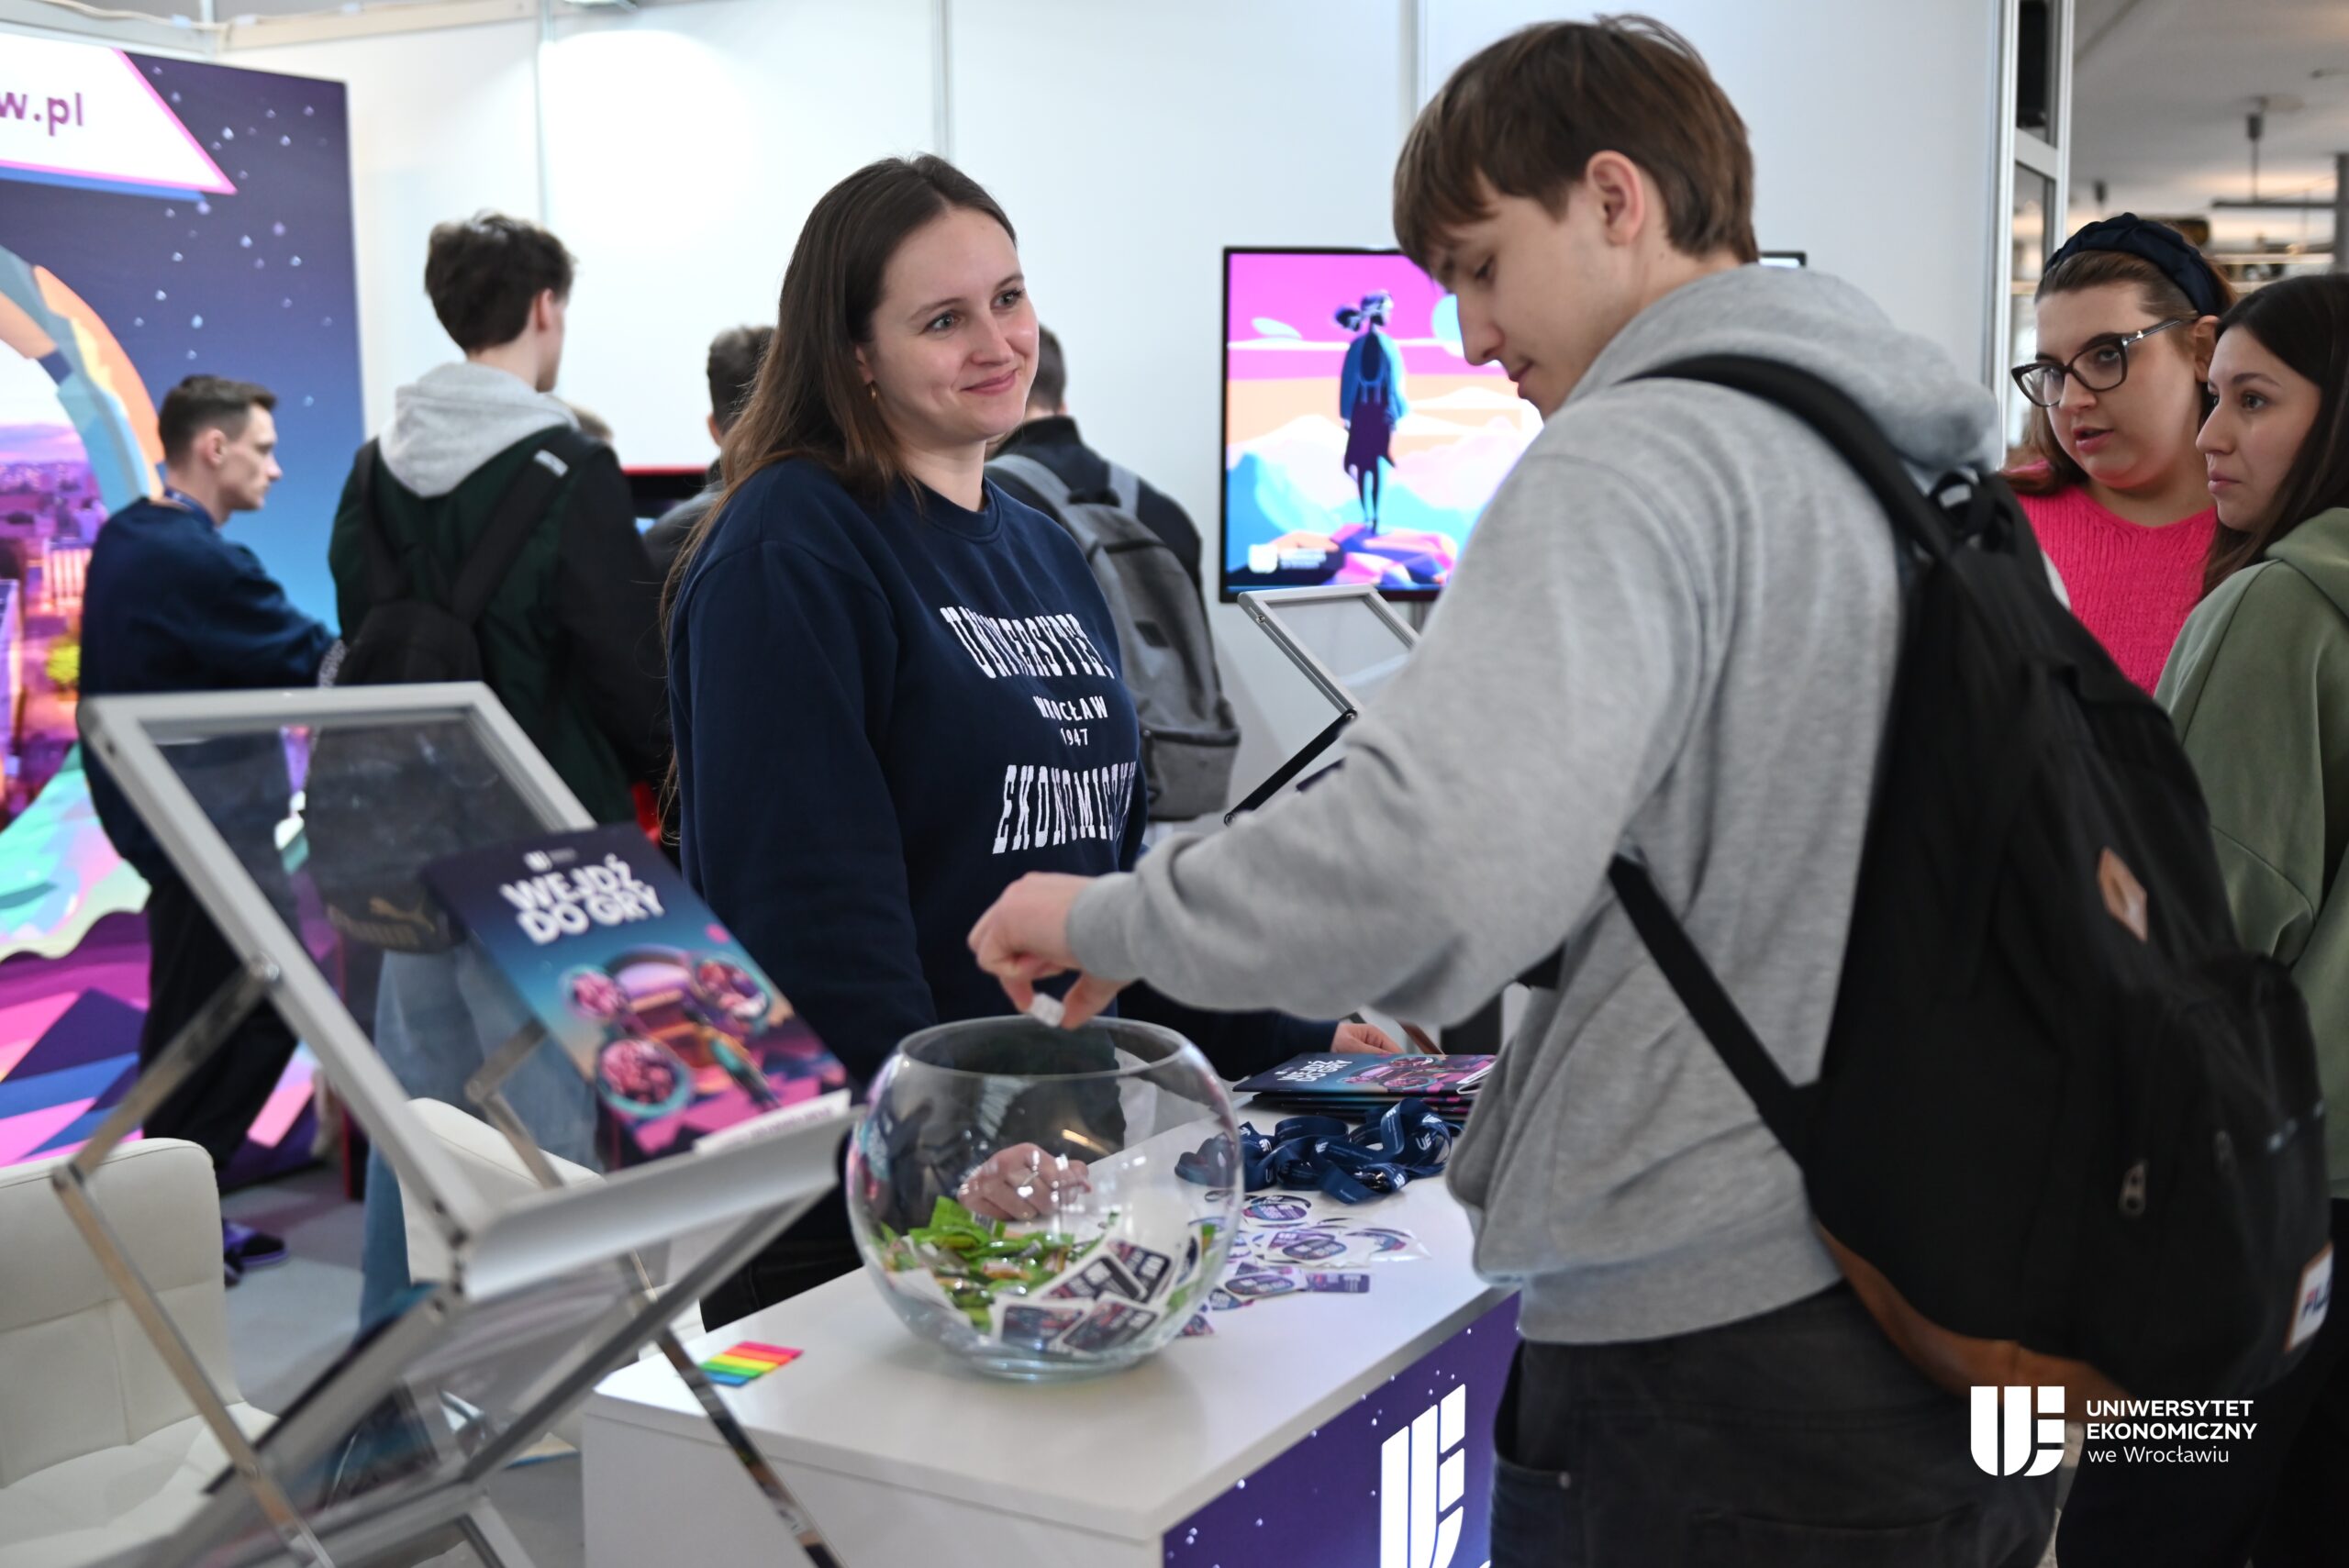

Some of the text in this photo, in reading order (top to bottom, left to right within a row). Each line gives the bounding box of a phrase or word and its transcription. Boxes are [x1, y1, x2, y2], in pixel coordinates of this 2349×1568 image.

[1032, 695, 1108, 721] WROCŁAW
[1060, 728, 1088, 746] 1947
[518, 879, 665, 945] DO GRY
[1415, 1132, 1432, 1151] UE
